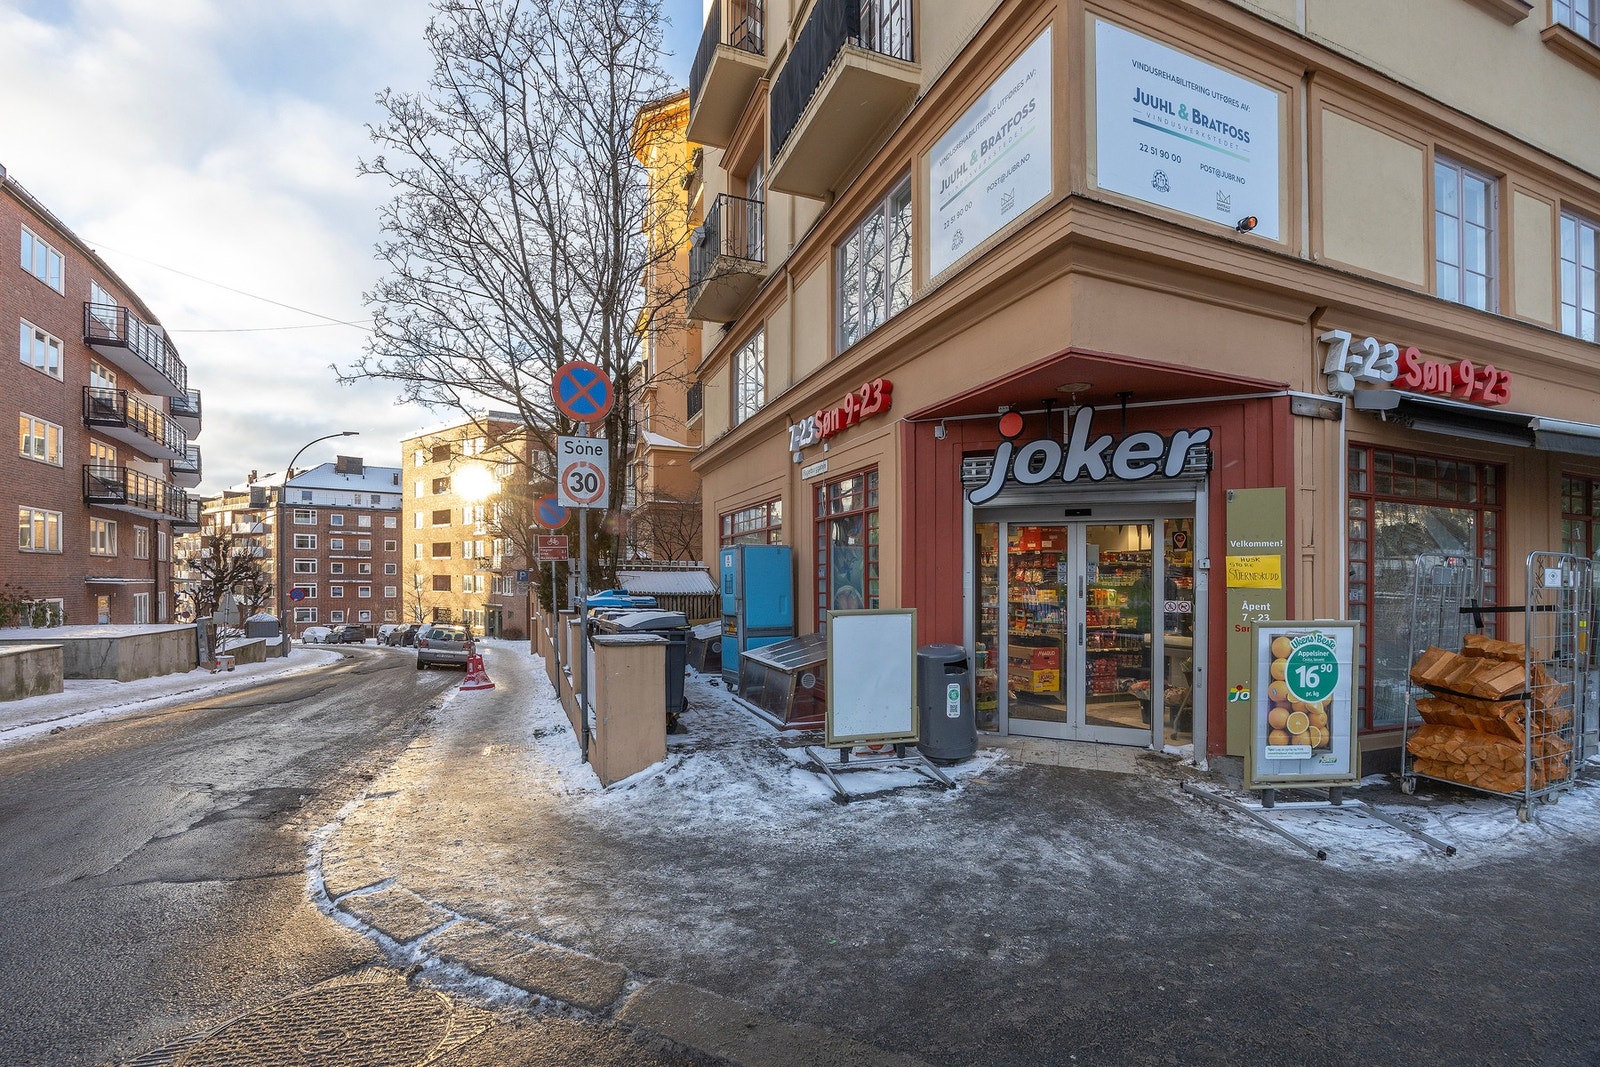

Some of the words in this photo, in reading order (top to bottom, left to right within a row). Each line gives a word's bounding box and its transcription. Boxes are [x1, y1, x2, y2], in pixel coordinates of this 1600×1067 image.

[1132, 59, 1210, 96] VINDUSREHABILITERING
[1211, 90, 1240, 108] UTFØRES
[1240, 101, 1251, 113] AV:
[1133, 87, 1175, 116] JUUHL
[1178, 103, 1189, 121] &
[1192, 108, 1251, 144] BRATFOSS
[1146, 112, 1239, 149] VINDUSVERKSTEDET
[939, 162, 969, 195] JUUHL
[969, 149, 978, 166] &
[980, 98, 1036, 157] BRATFOSS
[1139, 142, 1149, 153] 22
[1150, 146, 1158, 156] 51
[1159, 149, 1170, 159] 90
[1171, 153, 1182, 164] 00
[1200, 163, 1246, 185] POST@JUBR.NO
[1321, 330, 1398, 382] 7-23
[1402, 346, 1451, 392] Søn
[1459, 359, 1513, 404] 9-23
[788, 416, 815, 452] 7-23
[815, 410, 840, 438] Søn
[843, 378, 884, 424] 9-23
[968, 404, 1212, 505] joker
[570, 471, 598, 493] 30
[1230, 540, 1283, 548] Velkommen!
[1241, 600, 1271, 611] Åpent
[1242, 613, 1248, 621] 7
[1257, 613, 1270, 621] 23
[1290, 635, 1314, 649] Ukens
[1316, 634, 1336, 650] Beste
[1295, 665, 1320, 688] 16
[1320, 663, 1333, 673] 90
[1230, 685, 1250, 702] jo
